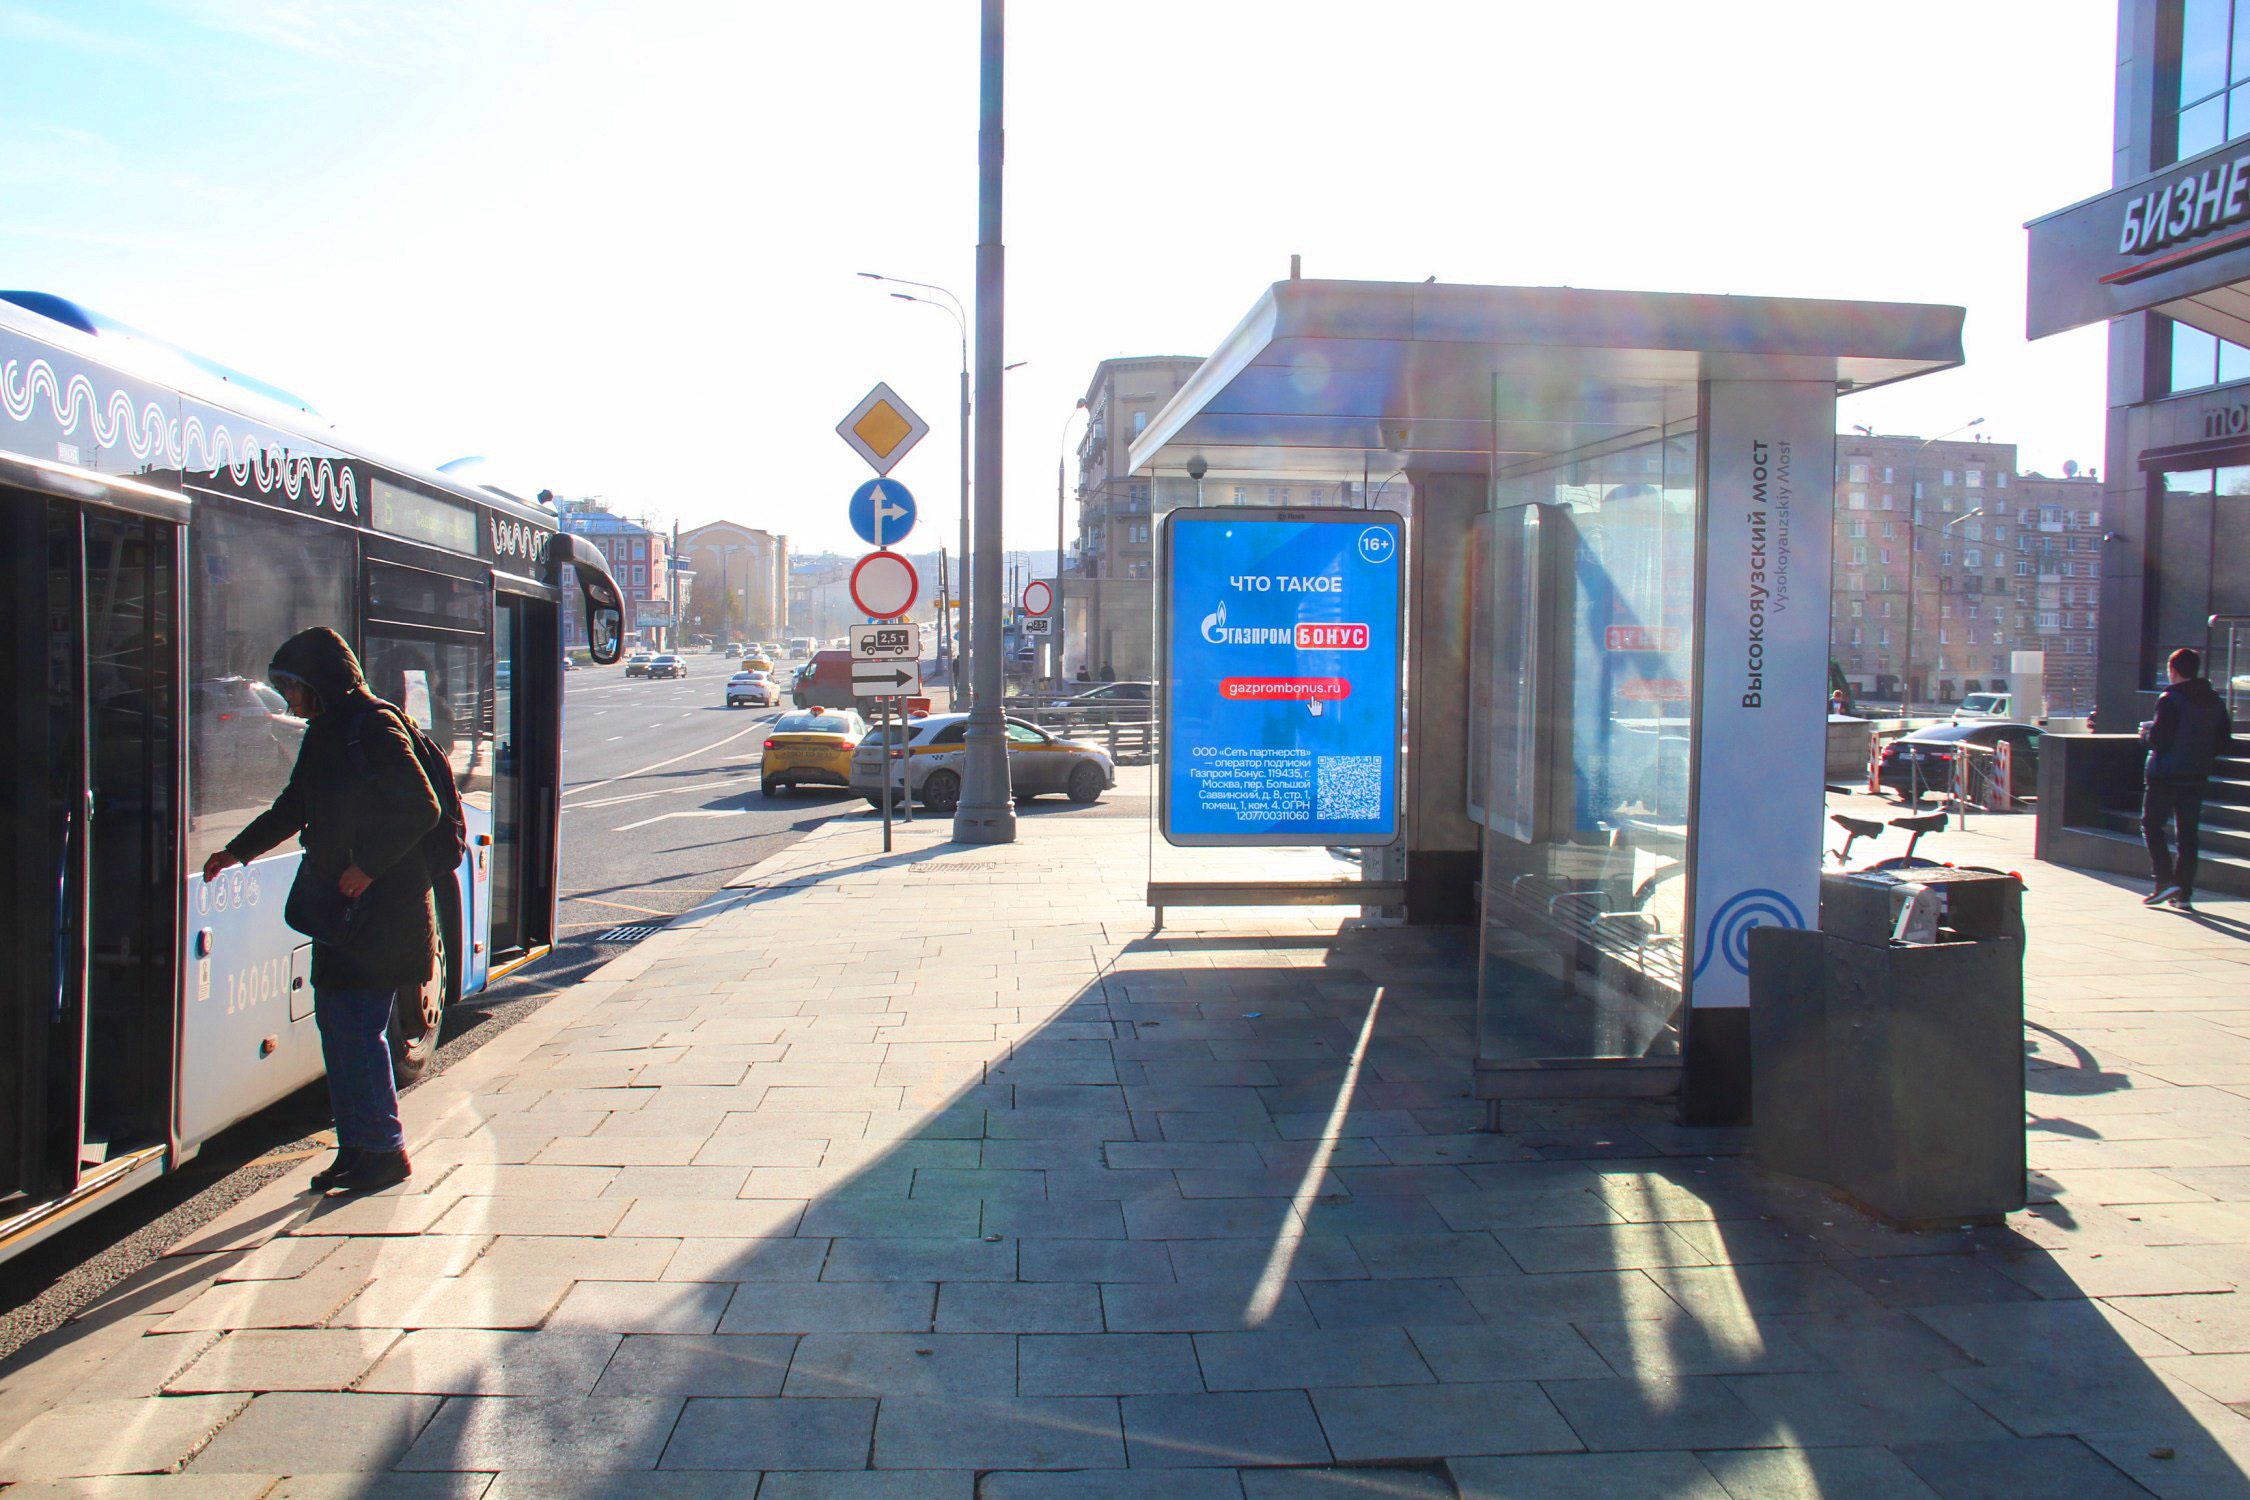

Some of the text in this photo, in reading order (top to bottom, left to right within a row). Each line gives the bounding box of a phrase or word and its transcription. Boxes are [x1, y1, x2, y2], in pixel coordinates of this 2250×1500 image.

[2118, 155, 2250, 255] БИЗНЕ
[1773, 440, 1792, 614] Vysokoyauzskiy Most
[1363, 538, 1389, 551] 16+
[1741, 440, 1769, 708] Высокояузский мост
[1230, 575, 1343, 593] ЧТО ТАКОЕ
[880, 633, 897, 644] 2,5
[1228, 628, 1364, 645] ГАЗПРОМ БОНУС
[1229, 683, 1341, 696] gazprombonus.ru
[1192, 747, 1311, 758] ООО «Сеть партнерств»
[1215, 760, 1262, 769] оператор
[1263, 760, 1311, 768] подписки
[1190, 769, 1311, 780] Газпром Бонус. 119435, г.
[1202, 779, 1311, 791] Москва, пер. Большой
[1198, 790, 1261, 800] Саввинский,
[1262, 791, 1271, 800] д.
[1283, 791, 1303, 801] стр.
[1202, 802, 1239, 811] помещ.
[1248, 802, 1270, 810] ком.
[1271, 801, 1280, 810] 4.
[1281, 801, 1311, 810] ОГРН
[1236, 811, 1310, 820] 1207700311060
[226, 954, 289, 1015] 160610
